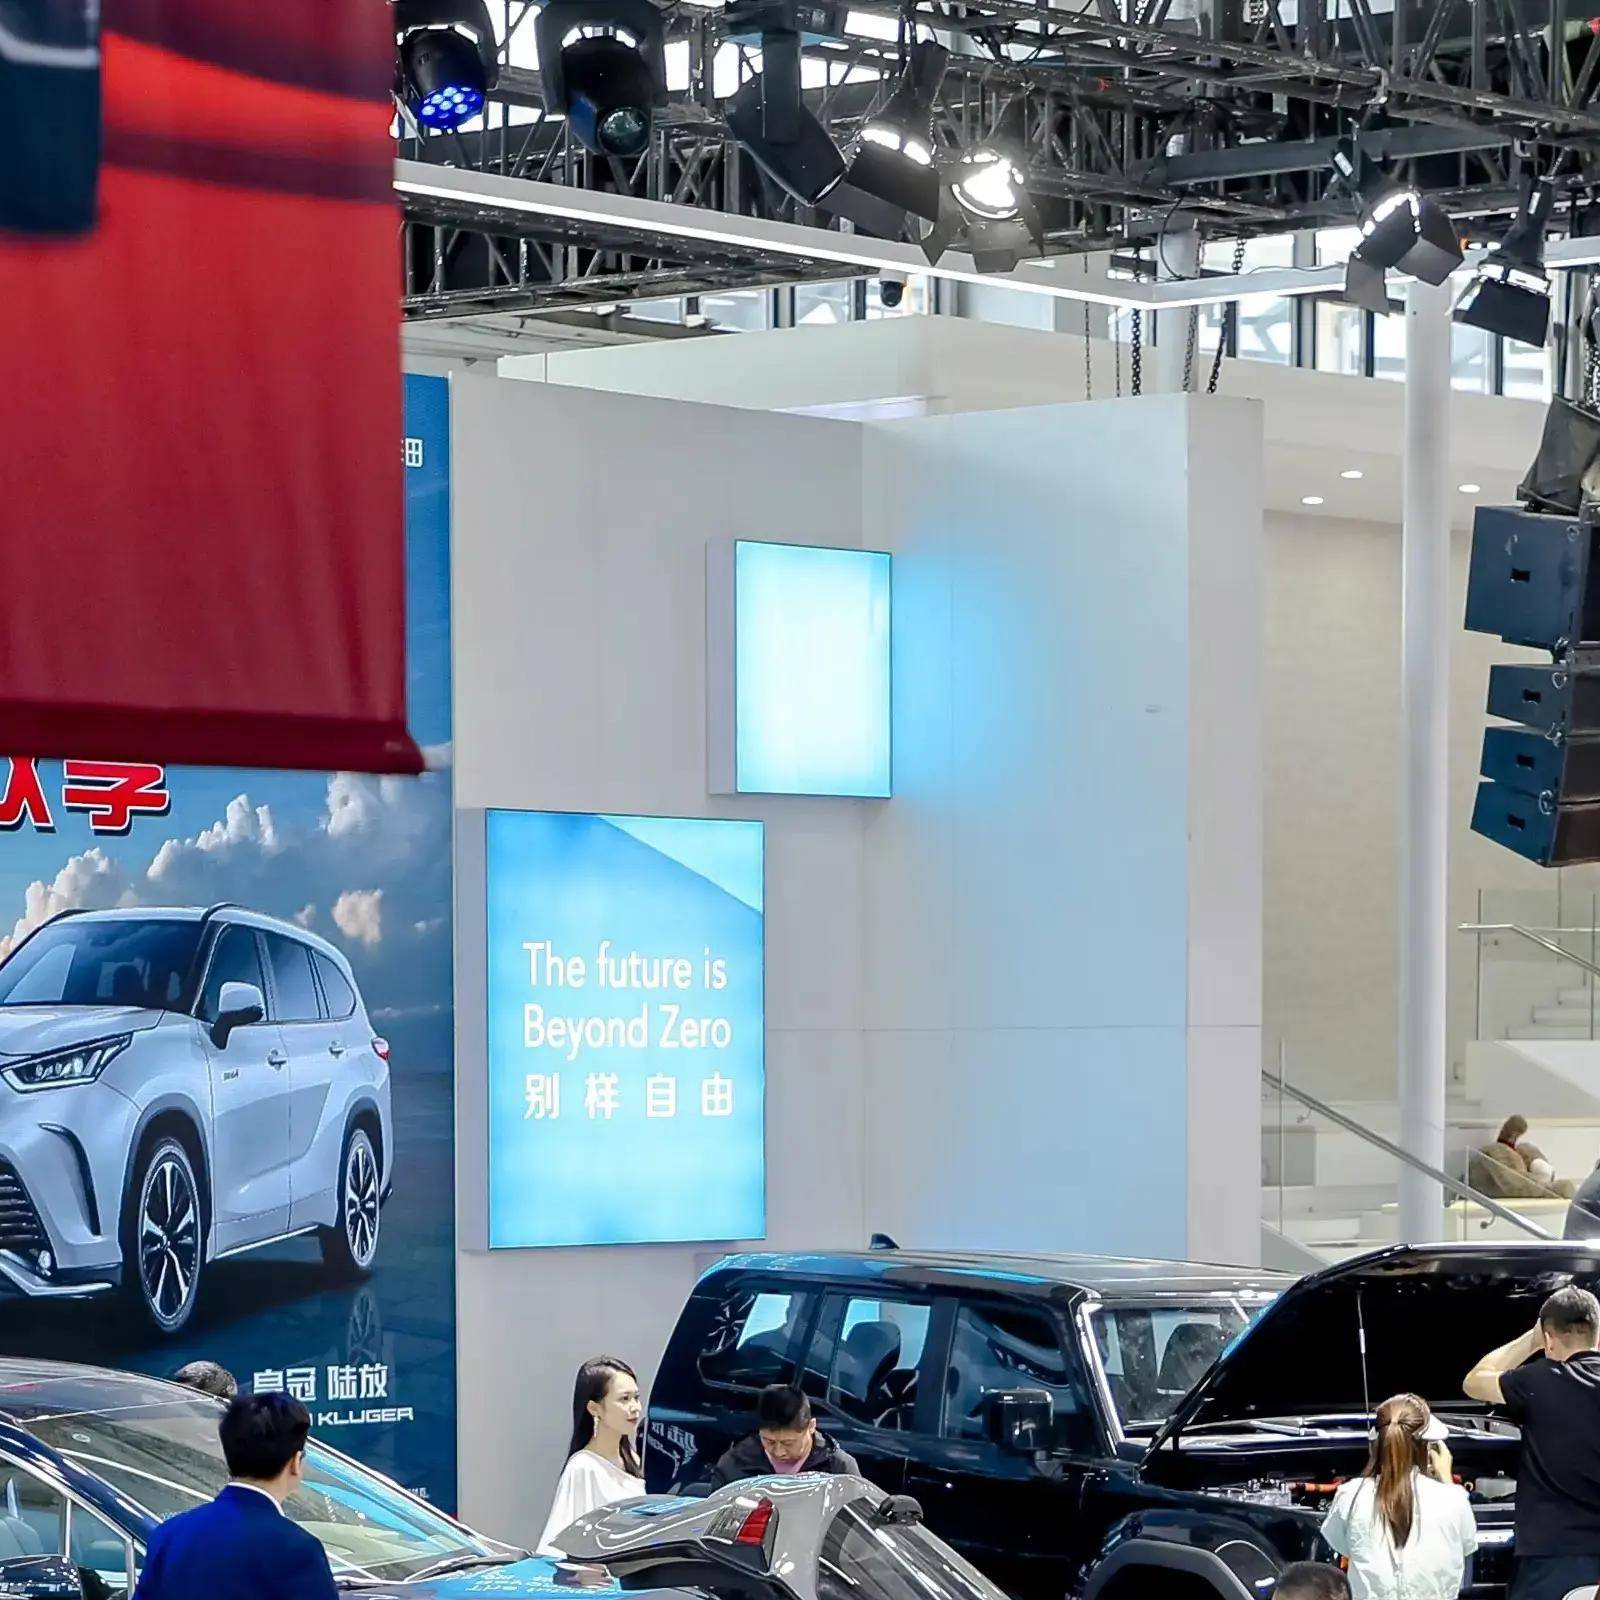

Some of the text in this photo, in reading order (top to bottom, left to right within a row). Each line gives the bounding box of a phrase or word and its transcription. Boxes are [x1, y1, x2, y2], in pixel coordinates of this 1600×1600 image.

[522, 939, 728, 990] The future is
[523, 1002, 732, 1061] Beyond Zero
[522, 1071, 734, 1120] 别样自由
[253, 1362, 388, 1401] 皇冠 陆放
[318, 1406, 414, 1426] KLUGER
